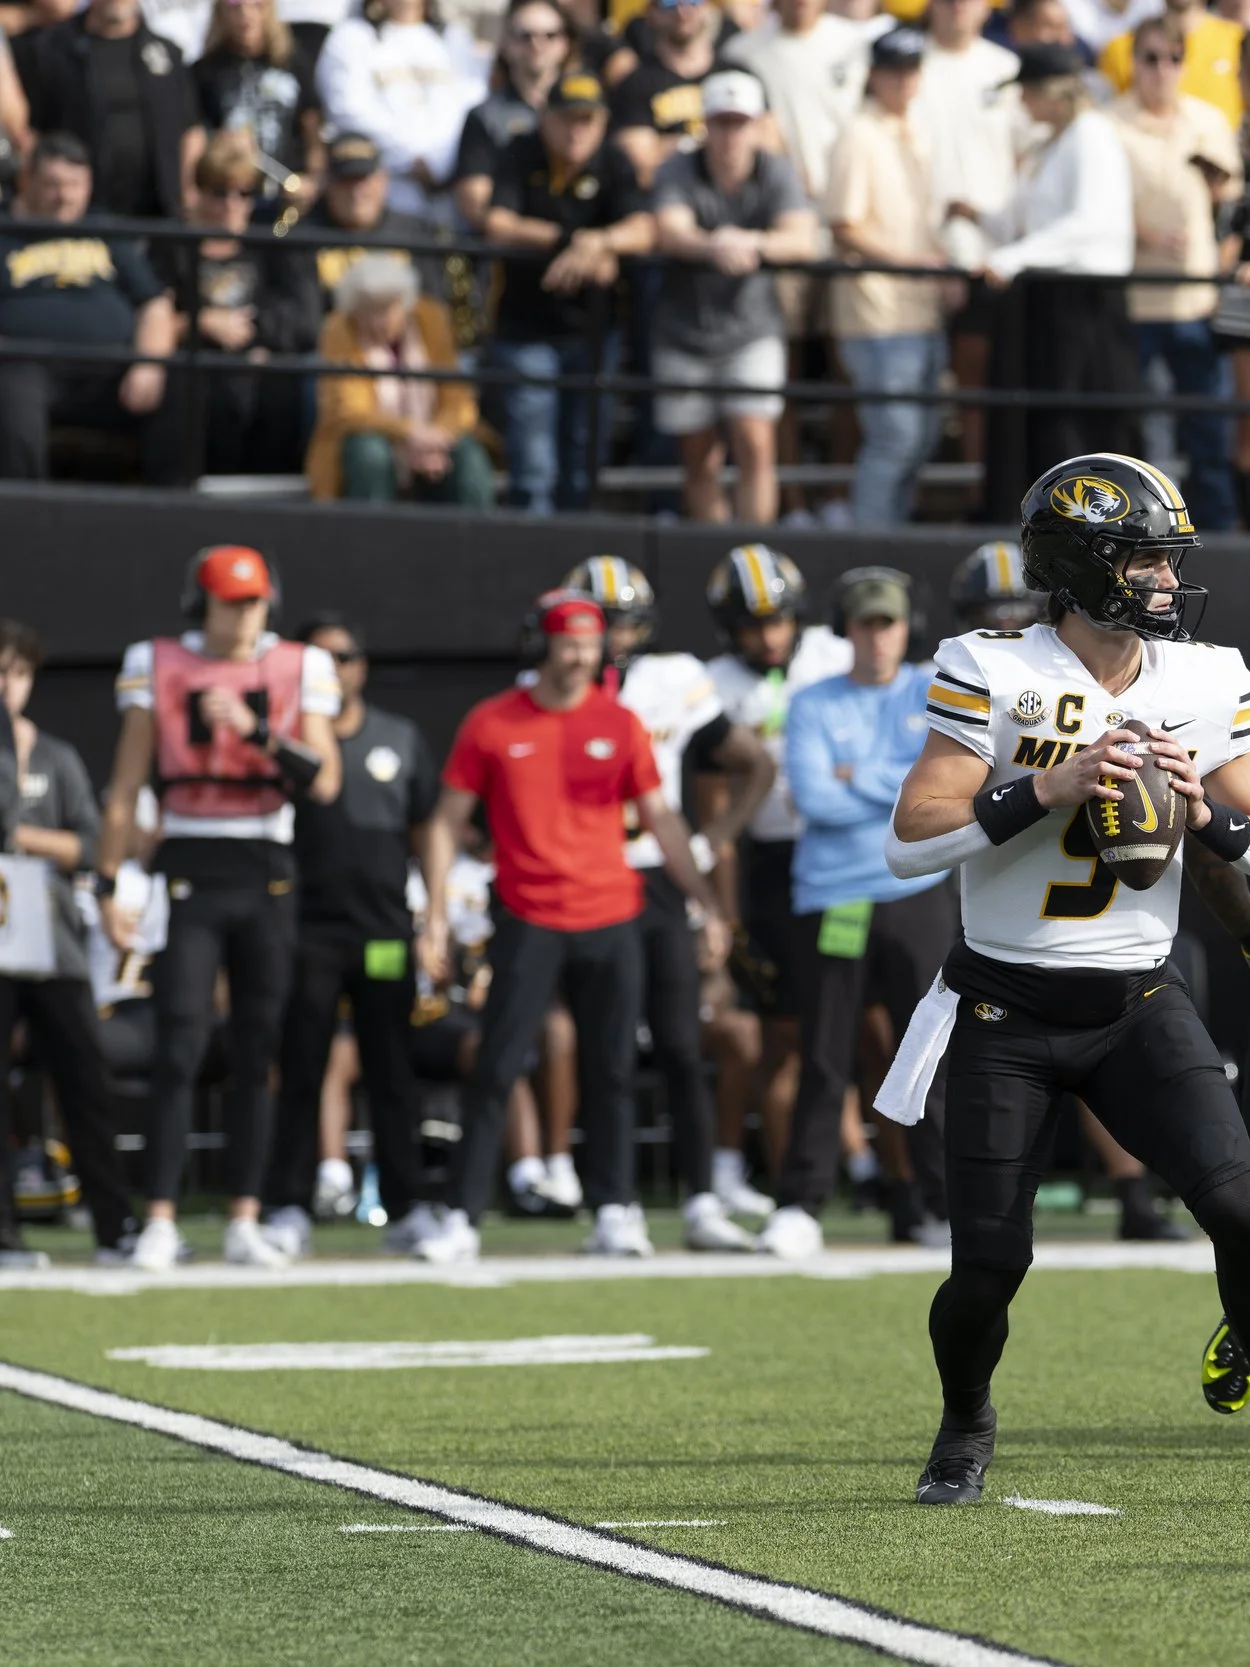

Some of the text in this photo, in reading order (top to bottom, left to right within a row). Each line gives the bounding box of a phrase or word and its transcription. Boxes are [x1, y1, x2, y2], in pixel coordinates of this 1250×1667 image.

[1018, 690, 1042, 715] SEC
[1053, 691, 1086, 737] C
[1012, 714, 1047, 727] GRADUATE
